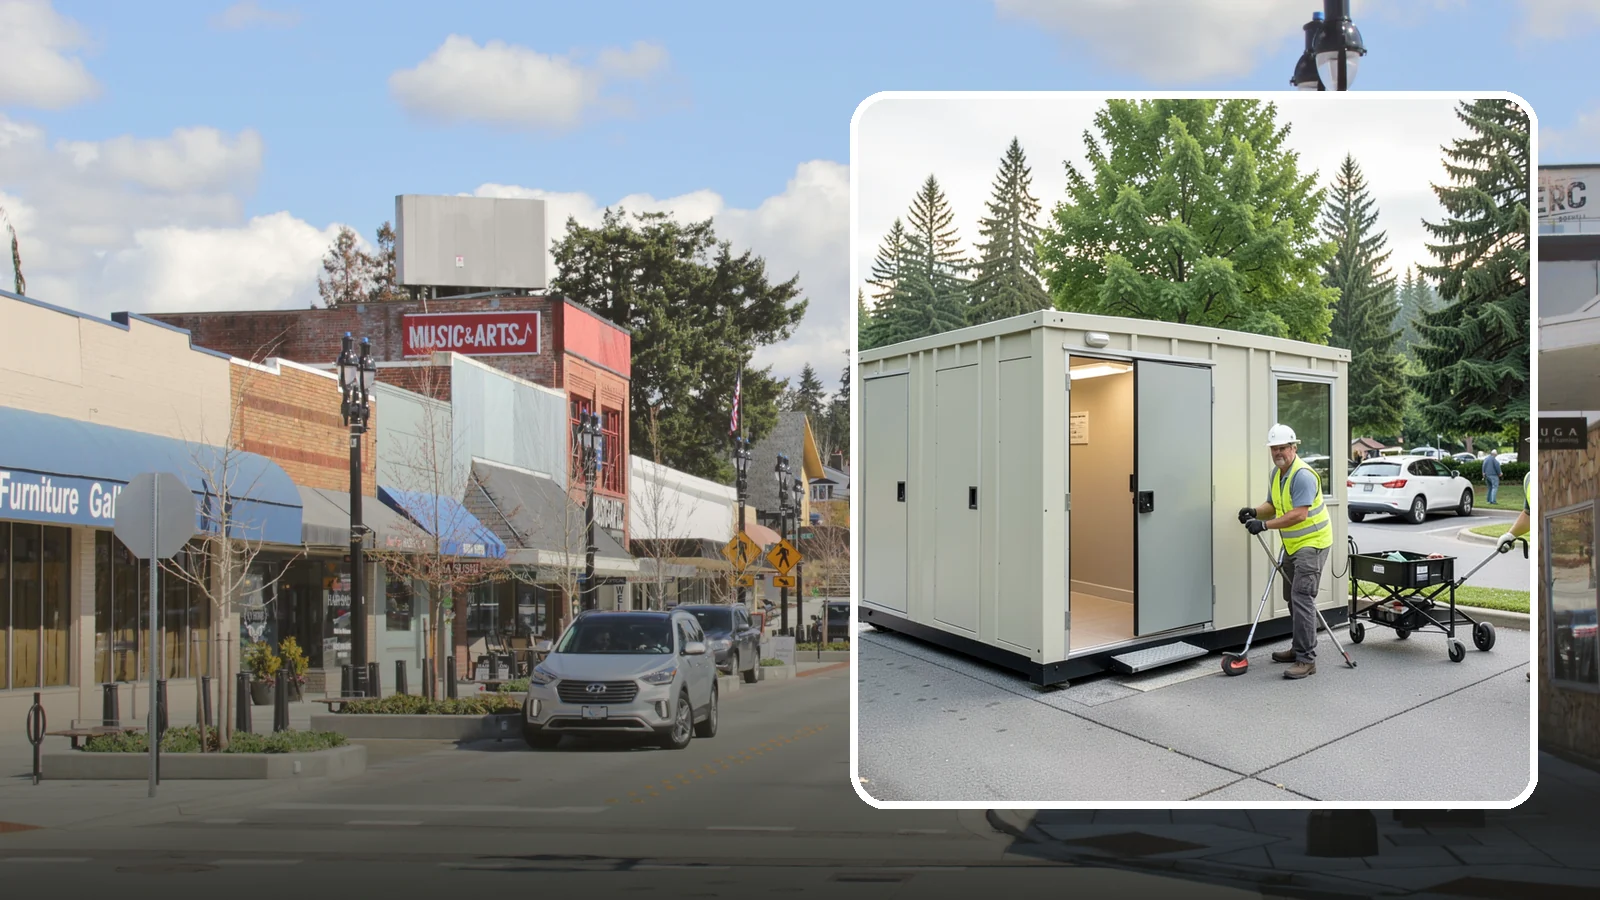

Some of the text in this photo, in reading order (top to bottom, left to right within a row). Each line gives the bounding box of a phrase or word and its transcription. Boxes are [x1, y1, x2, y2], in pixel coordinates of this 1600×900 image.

[408, 322, 520, 349] MUSIC&ARTS
[0, 471, 80, 515] Furniture
[453, 563, 480, 574] SUSHI
